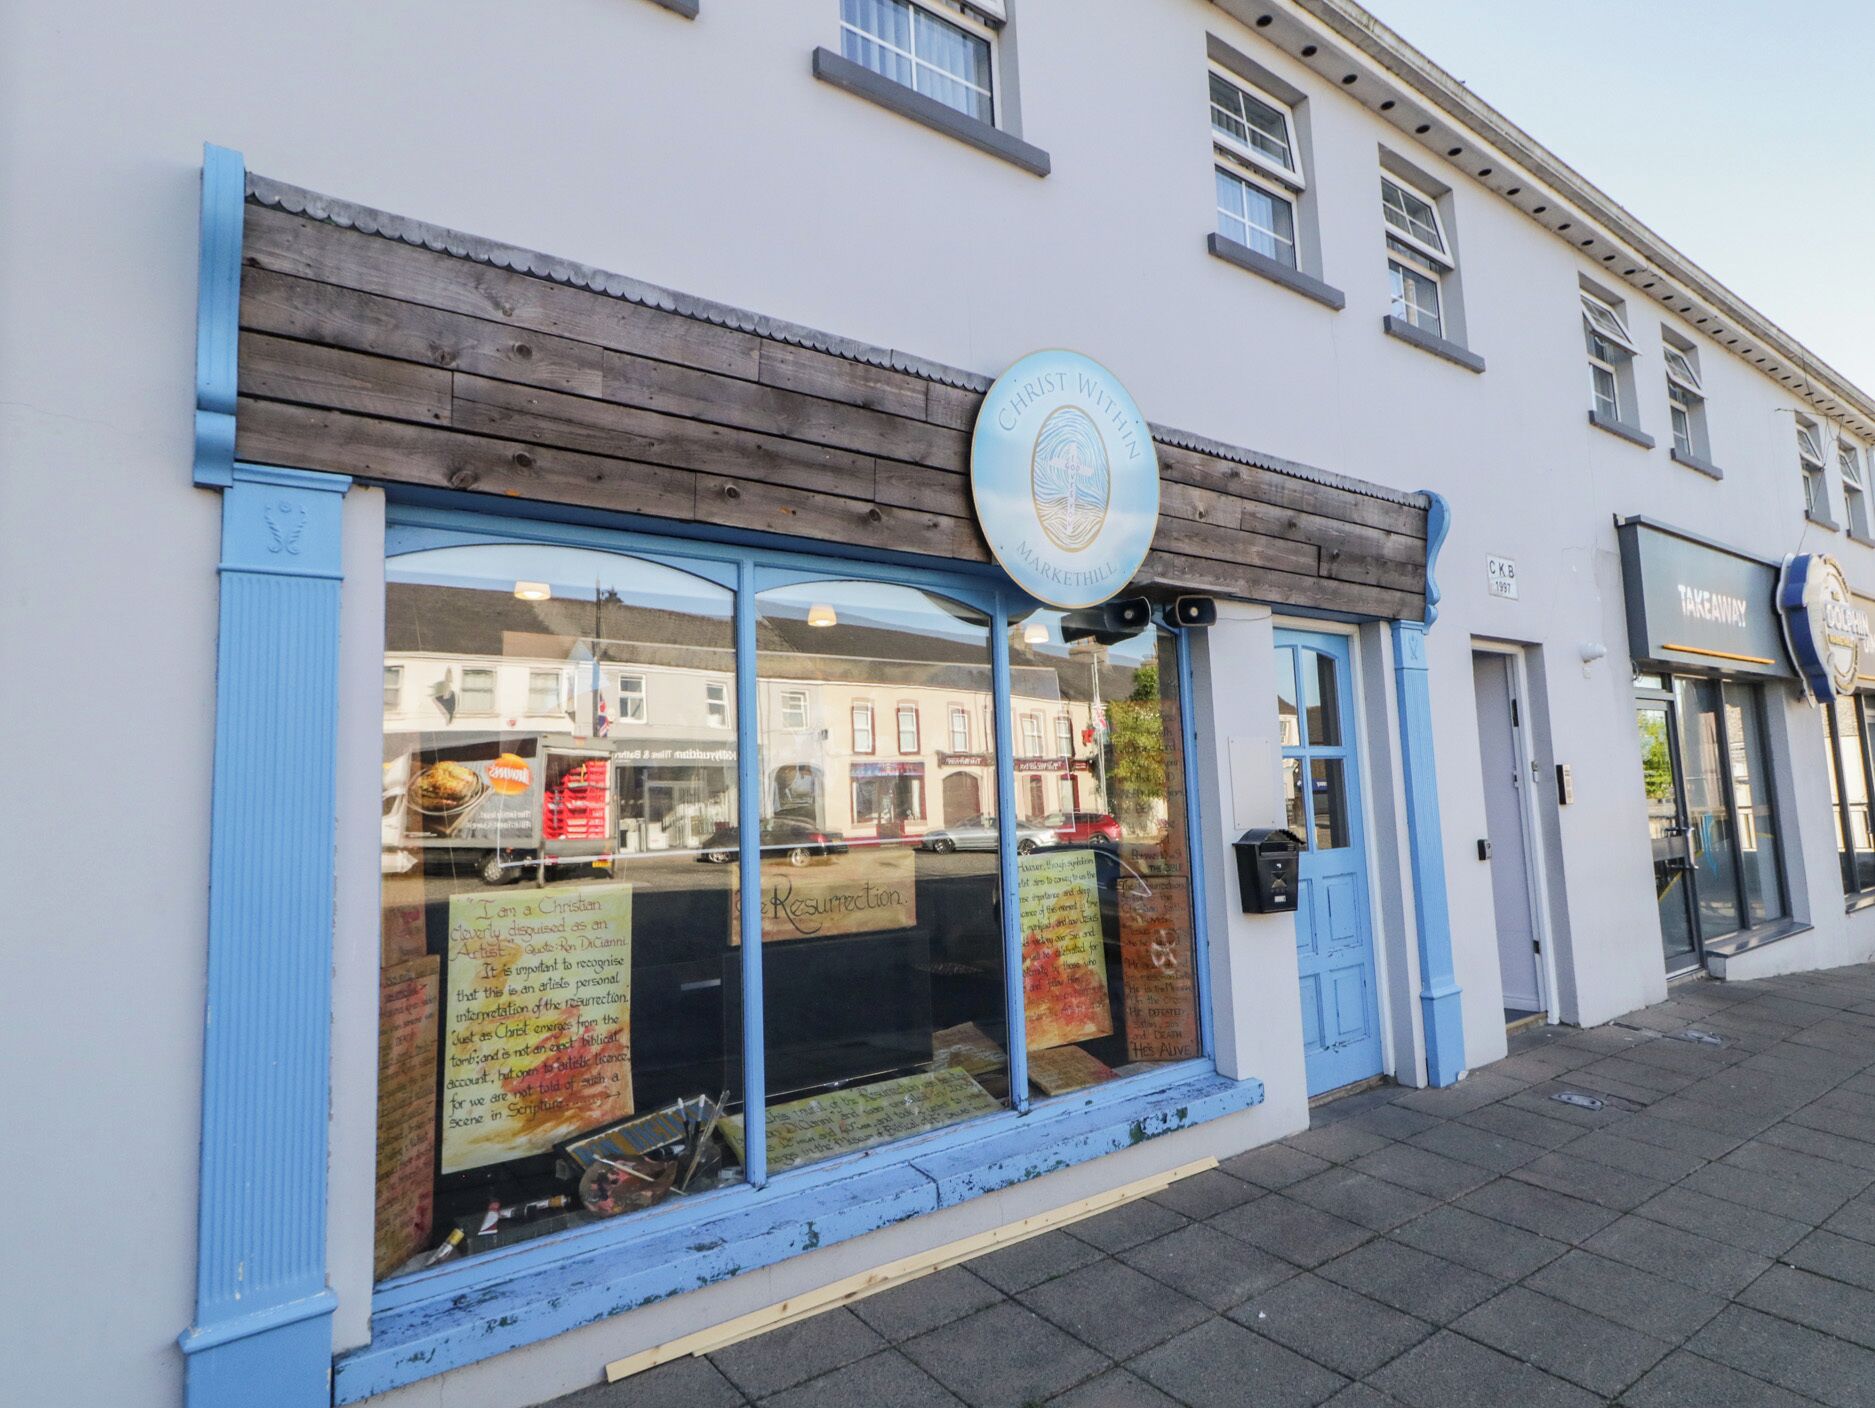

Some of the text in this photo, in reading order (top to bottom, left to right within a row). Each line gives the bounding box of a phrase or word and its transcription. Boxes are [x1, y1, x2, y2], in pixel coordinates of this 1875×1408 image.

[998, 372, 1141, 461] CHRIST WITHIN
[1016, 540, 1119, 586] MARKETHILL
[1495, 581, 1511, 594] 1997
[1678, 585, 1746, 627] TAKEAWAY
[496, 906, 517, 919] am
[522, 905, 532, 917] a
[538, 892, 602, 914] Christian
[508, 917, 566, 943] disguised
[570, 922, 587, 933] as
[591, 919, 609, 930] an
[481, 954, 625, 982] It is important to recognise
[456, 972, 621, 1003] that this is an artists personal
[455, 1003, 530, 1025] interpretation
[531, 998, 546, 1019] of
[545, 997, 562, 1011] the
[478, 1032, 492, 1042] as
[495, 1020, 530, 1039] Christ
[533, 1021, 573, 1038] emerges
[575, 1014, 598, 1033] from
[602, 1013, 620, 1025] the
[480, 1049, 499, 1062] and
[501, 1047, 511, 1060] is
[514, 1043, 531, 1058] not
[533, 1045, 547, 1056] an
[549, 1038, 576, 1055] exact
[582, 1032, 619, 1048] biblical
[497, 1067, 514, 1082] but
[514, 1066, 540, 1081] open
[544, 1059, 554, 1074] to
[450, 1072, 620, 1116] for we are not told of such a
[449, 1115, 484, 1129] scene
[491, 1109, 502, 1121] in
